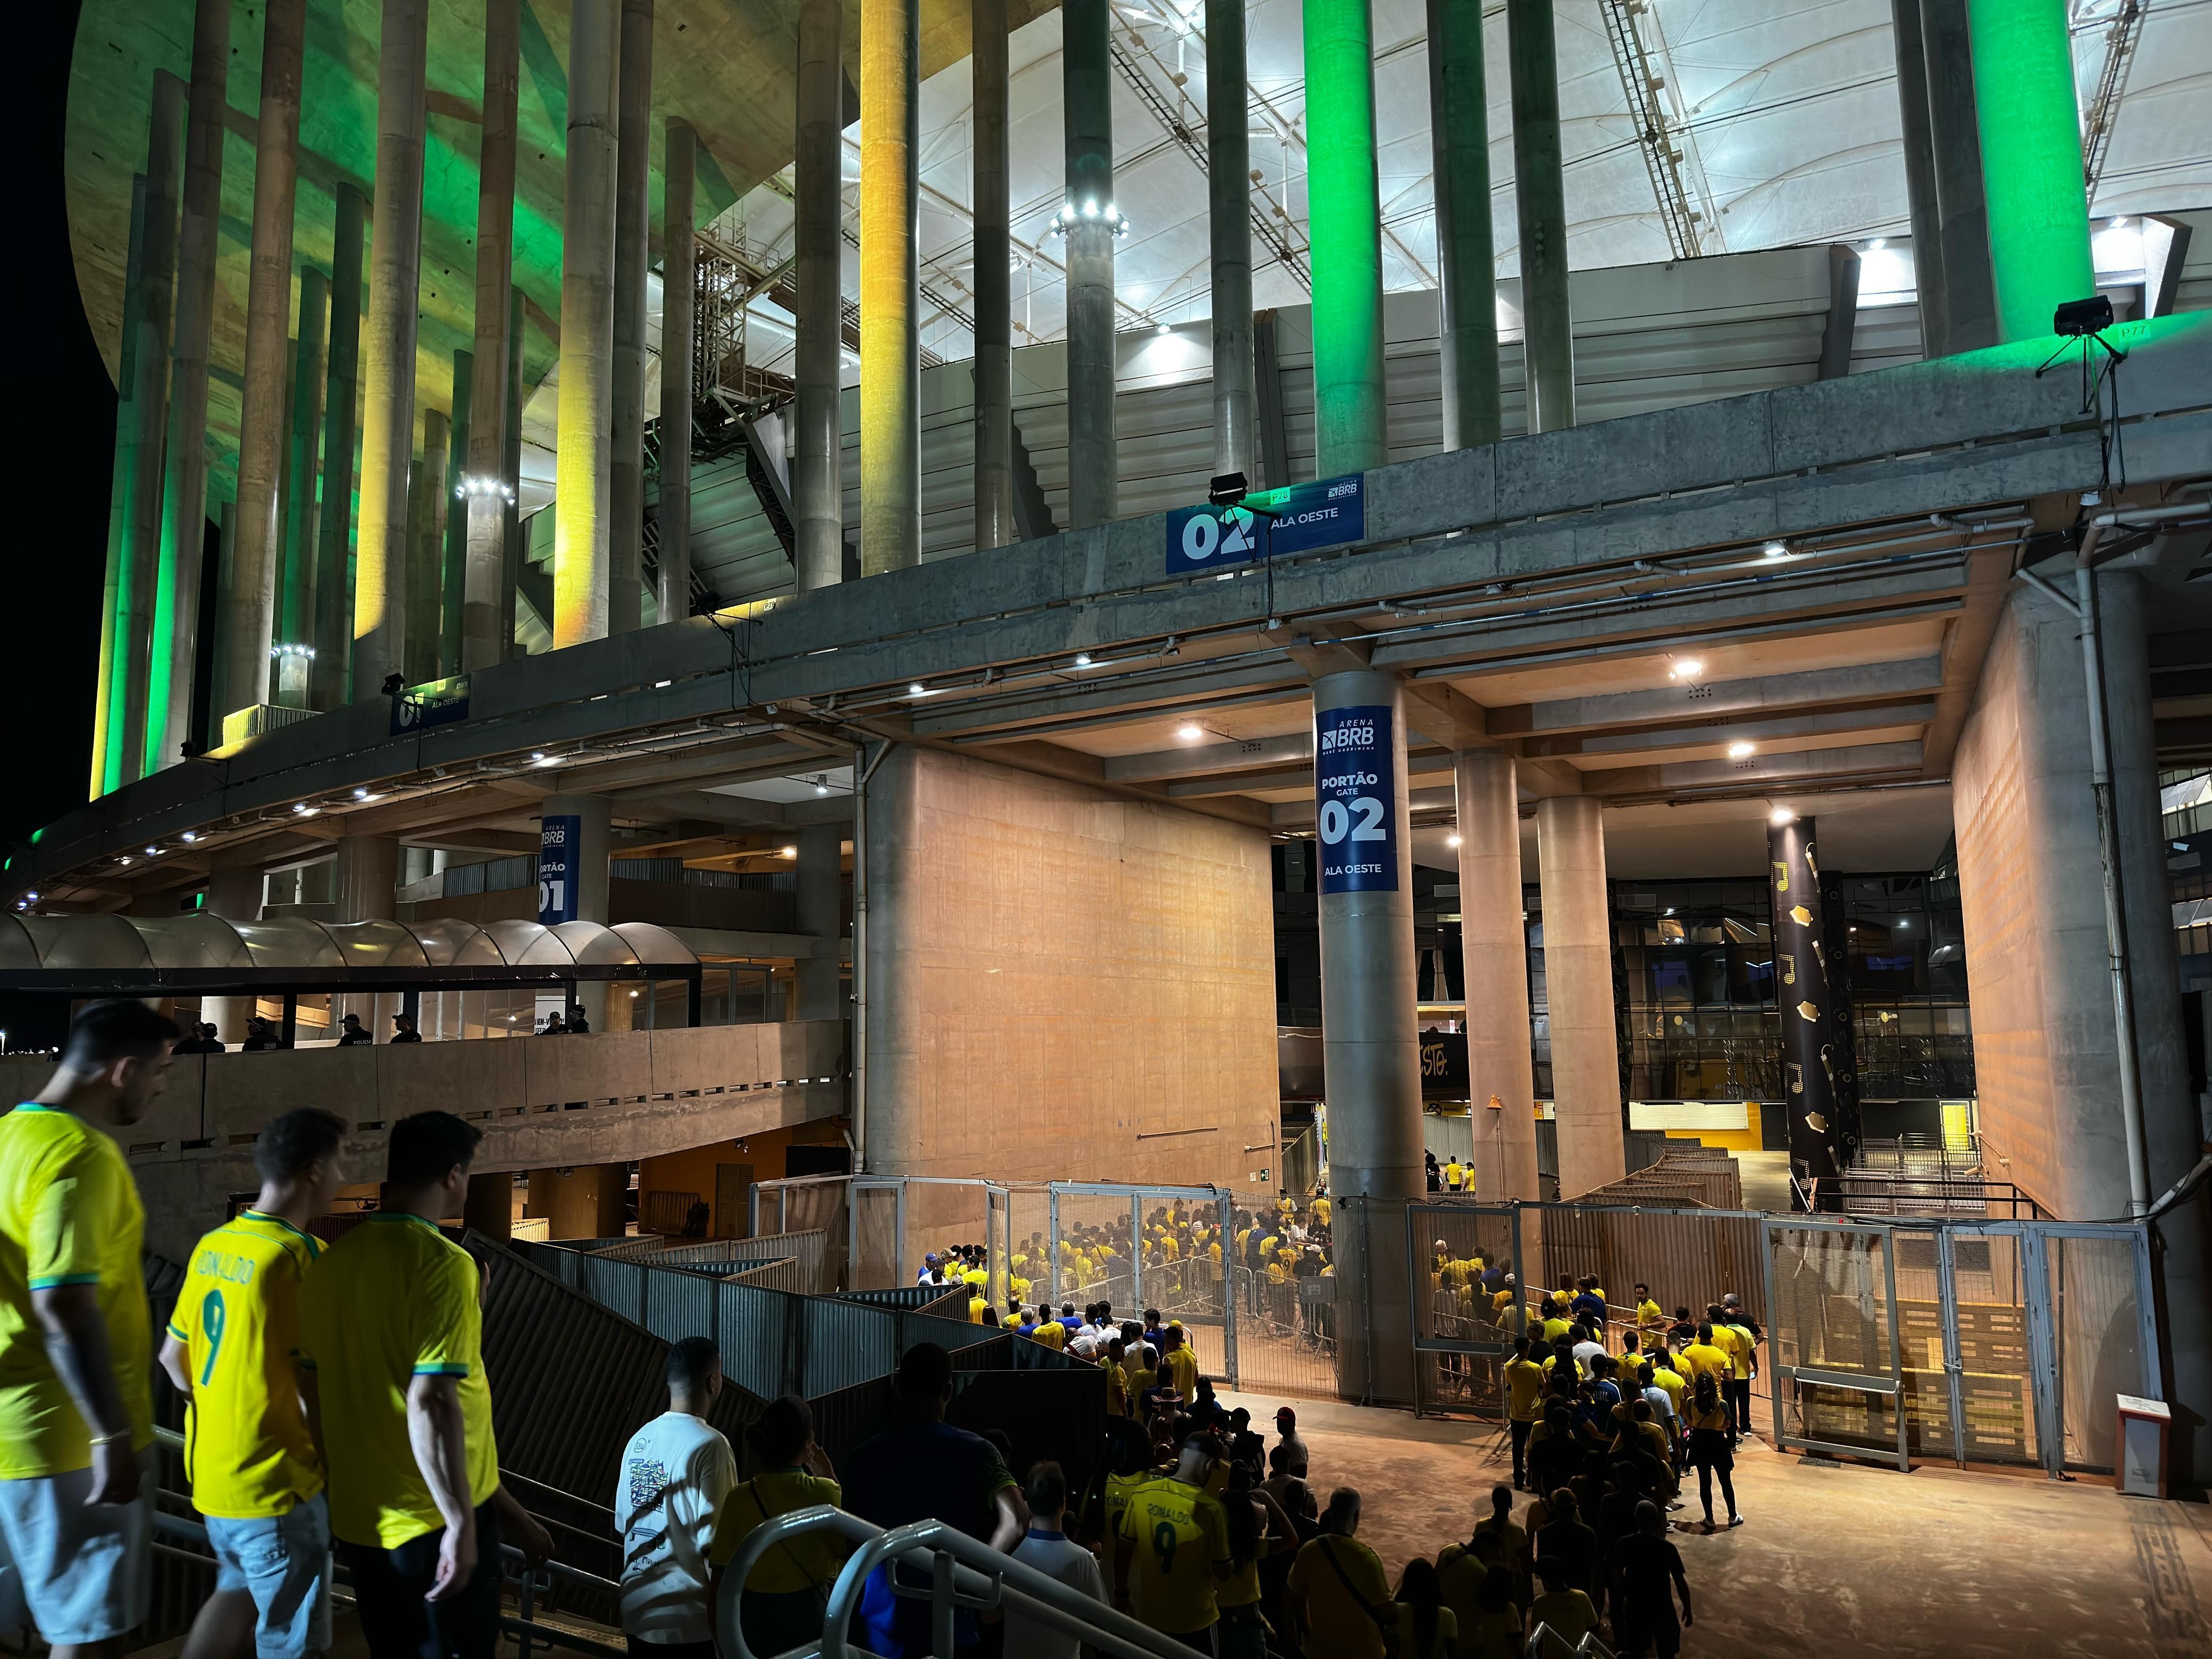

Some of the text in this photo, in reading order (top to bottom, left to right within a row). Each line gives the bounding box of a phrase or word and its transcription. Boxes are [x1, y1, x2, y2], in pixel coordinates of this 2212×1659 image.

[2121, 325, 2146, 338] P77
[1272, 491, 1288, 501] P78
[1338, 483, 1358, 496] BRB
[1271, 507, 1338, 530] ALA OESTE
[1182, 506, 1255, 560] 02
[443, 697, 459, 706] OESTE
[399, 692, 424, 727] 01
[1339, 719, 1373, 728] ARENA
[1337, 727, 1374, 747] BRB
[1322, 772, 1378, 790] PORTÃO
[1336, 788, 1359, 797] GATE
[1320, 797, 1387, 844] 02
[544, 831, 565, 844] BRB
[540, 862, 565, 873] ORTÃO
[1325, 864, 1382, 877] ALA OESTE
[539, 881, 564, 913] 01
[200, 1289, 225, 1387] 9
[1593, 1390, 1610, 1402] ASIL
[1147, 1503, 1189, 1525] RONALDO
[1154, 1521, 1177, 1574] 9
